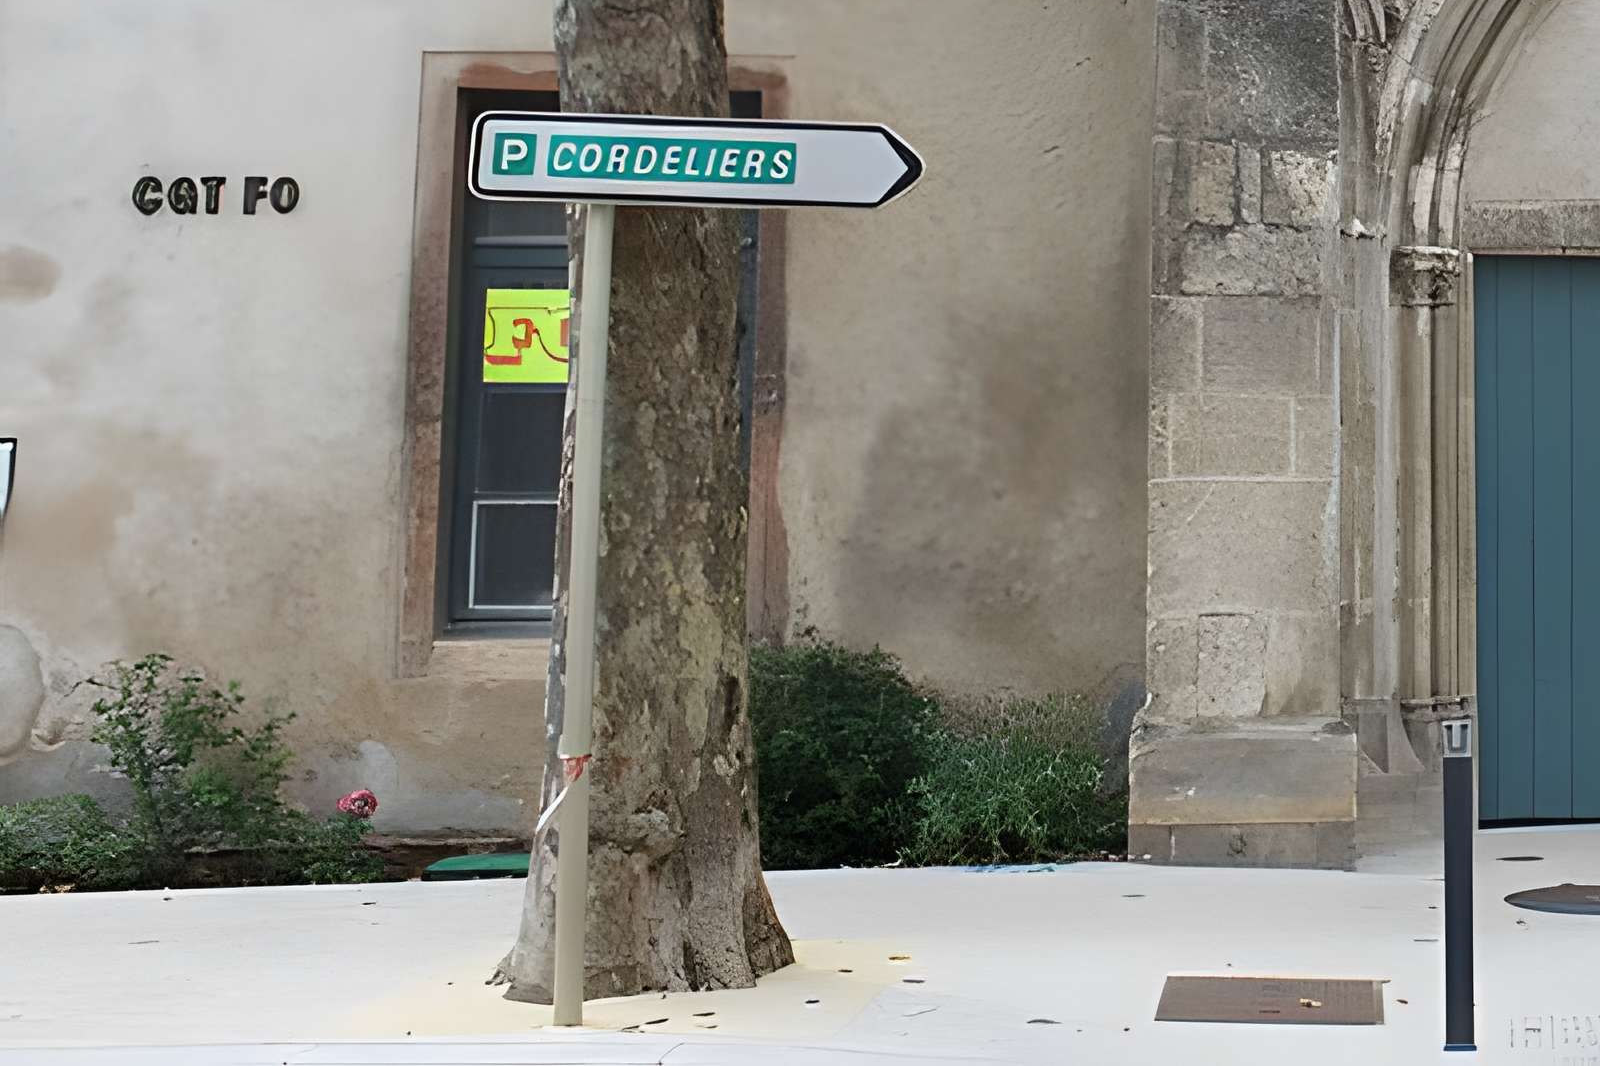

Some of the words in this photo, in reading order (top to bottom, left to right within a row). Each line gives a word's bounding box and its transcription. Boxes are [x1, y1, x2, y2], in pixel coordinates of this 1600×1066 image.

[500, 139, 529, 170] P
[552, 141, 793, 180] CORDELIERS
[243, 176, 300, 215] FO
